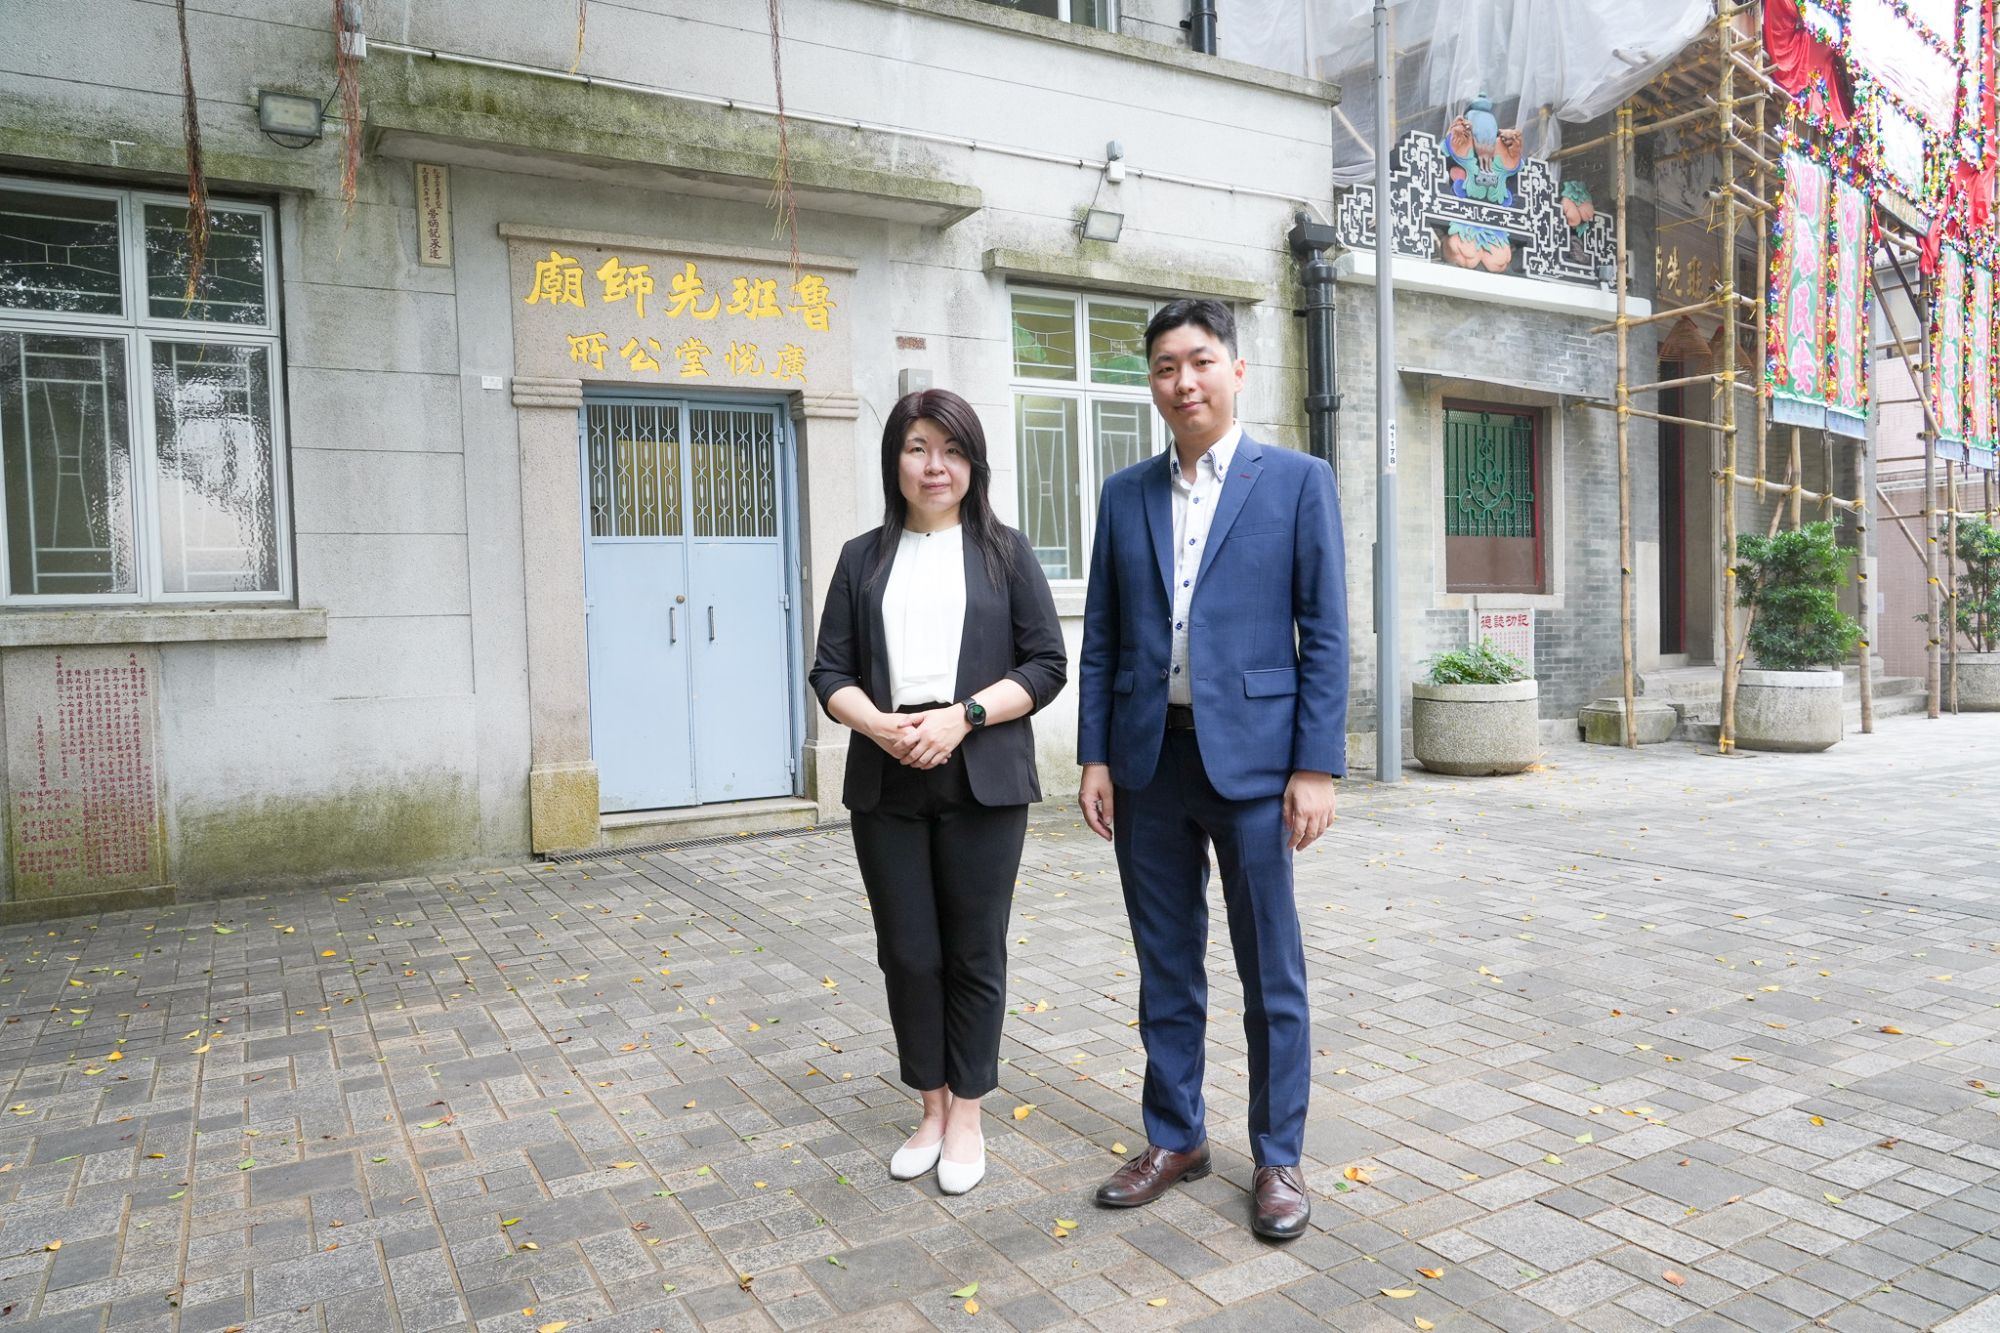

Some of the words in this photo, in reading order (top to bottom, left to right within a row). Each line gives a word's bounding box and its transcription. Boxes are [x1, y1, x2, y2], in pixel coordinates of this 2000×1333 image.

[524, 250, 837, 332] 魯班先師廟
[566, 331, 808, 383] 廣悅堂公所
